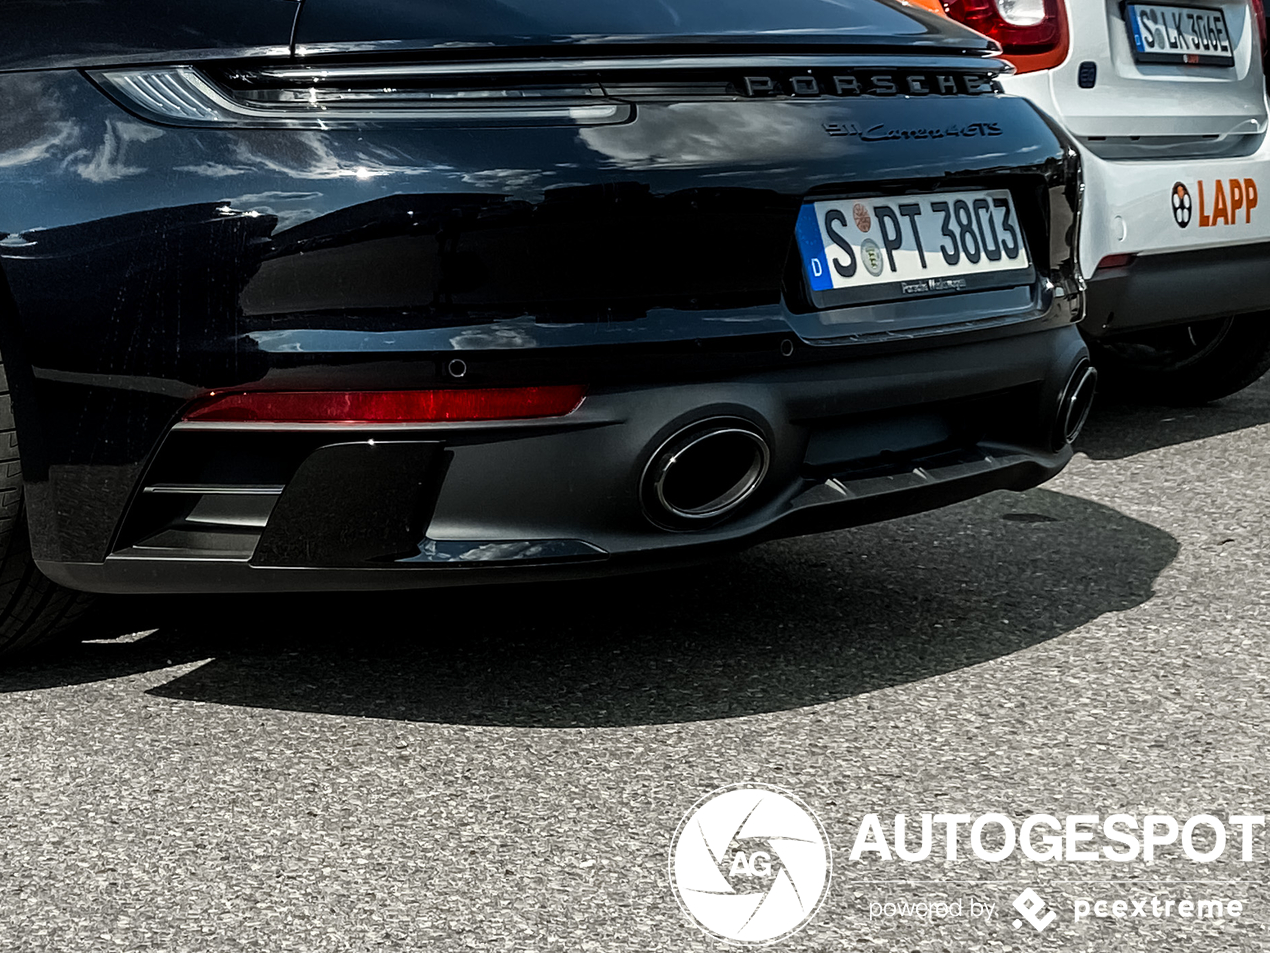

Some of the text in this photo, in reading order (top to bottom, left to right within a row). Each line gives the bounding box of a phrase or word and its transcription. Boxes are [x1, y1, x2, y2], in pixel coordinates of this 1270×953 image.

[1139, 9, 1229, 52] S LK 306E
[743, 75, 992, 96] PORSCHE
[1197, 178, 1258, 228] LAPP
[825, 197, 1020, 278] S PT 3803
[811, 257, 823, 277] D
